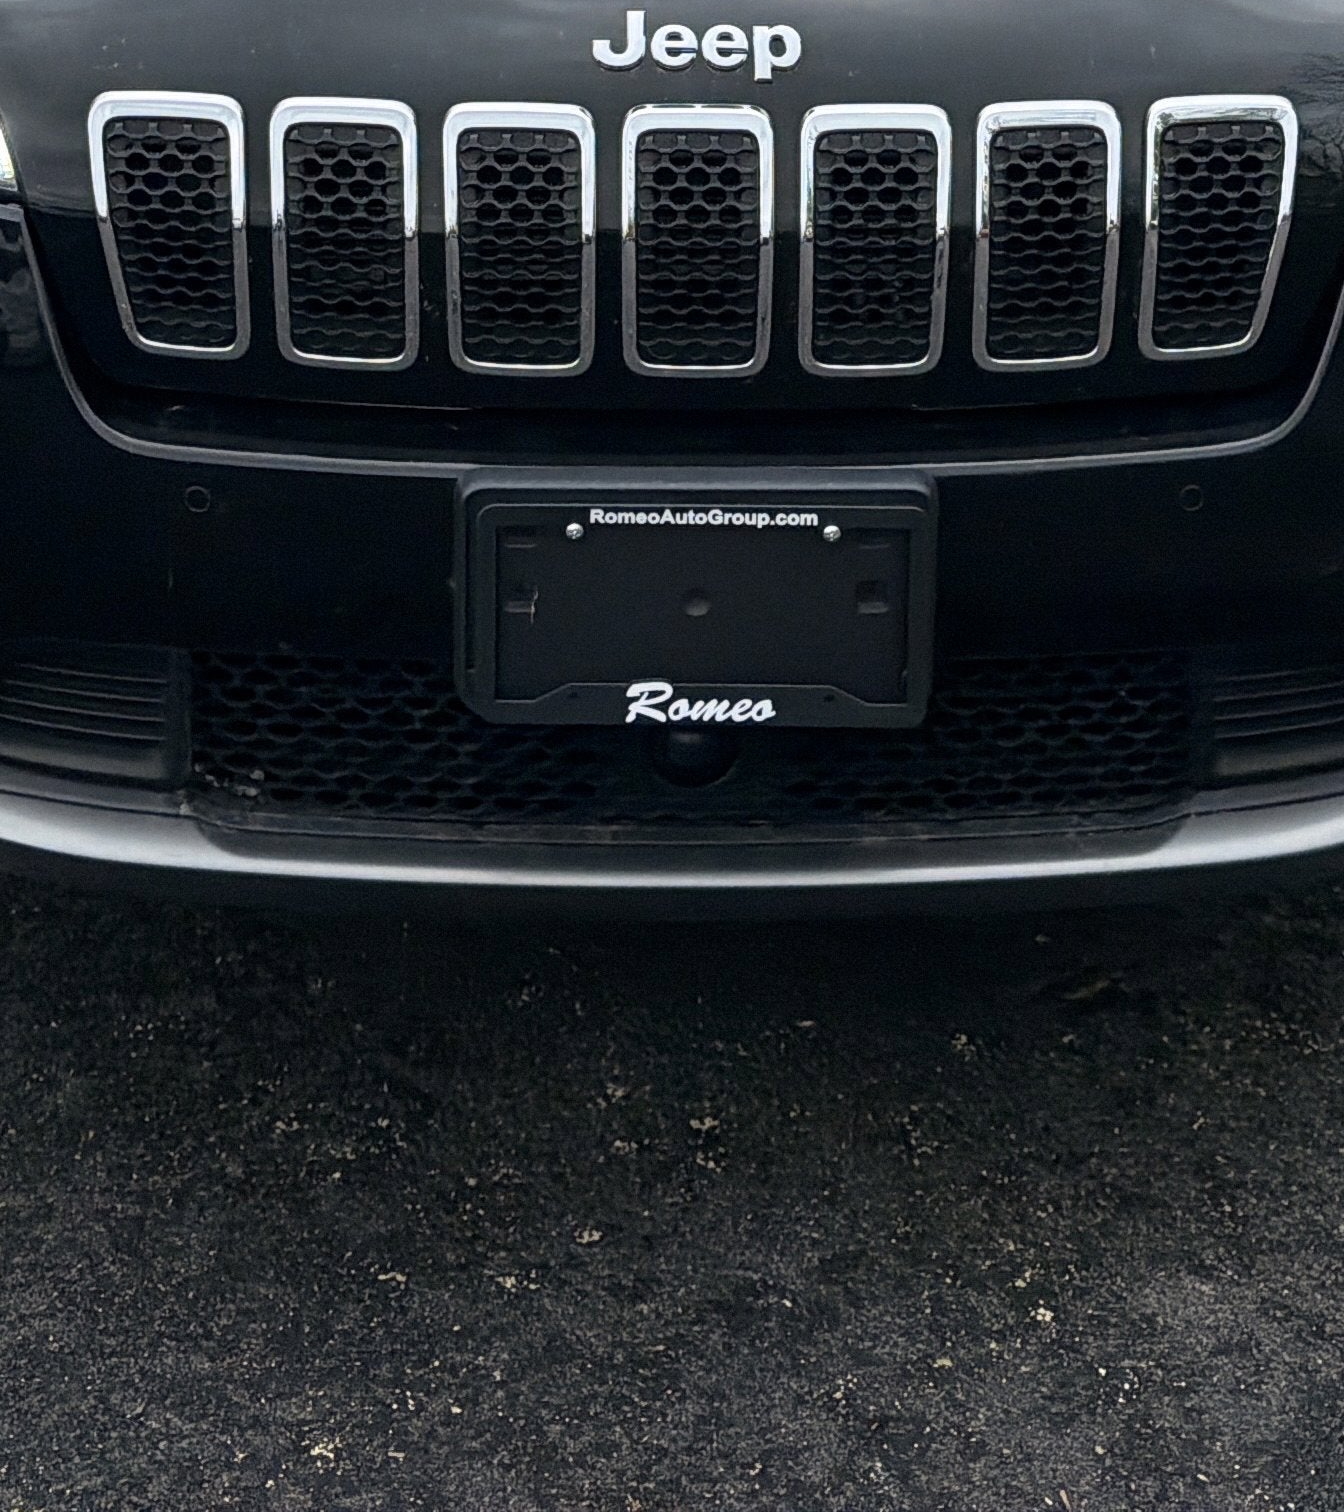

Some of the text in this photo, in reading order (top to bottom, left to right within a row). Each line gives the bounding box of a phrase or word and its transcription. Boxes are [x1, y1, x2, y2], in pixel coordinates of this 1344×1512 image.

[592, 9, 802, 83] Jeep
[589, 509, 819, 529] RomeoAutoGroup.com
[625, 681, 776, 724] Romeo
